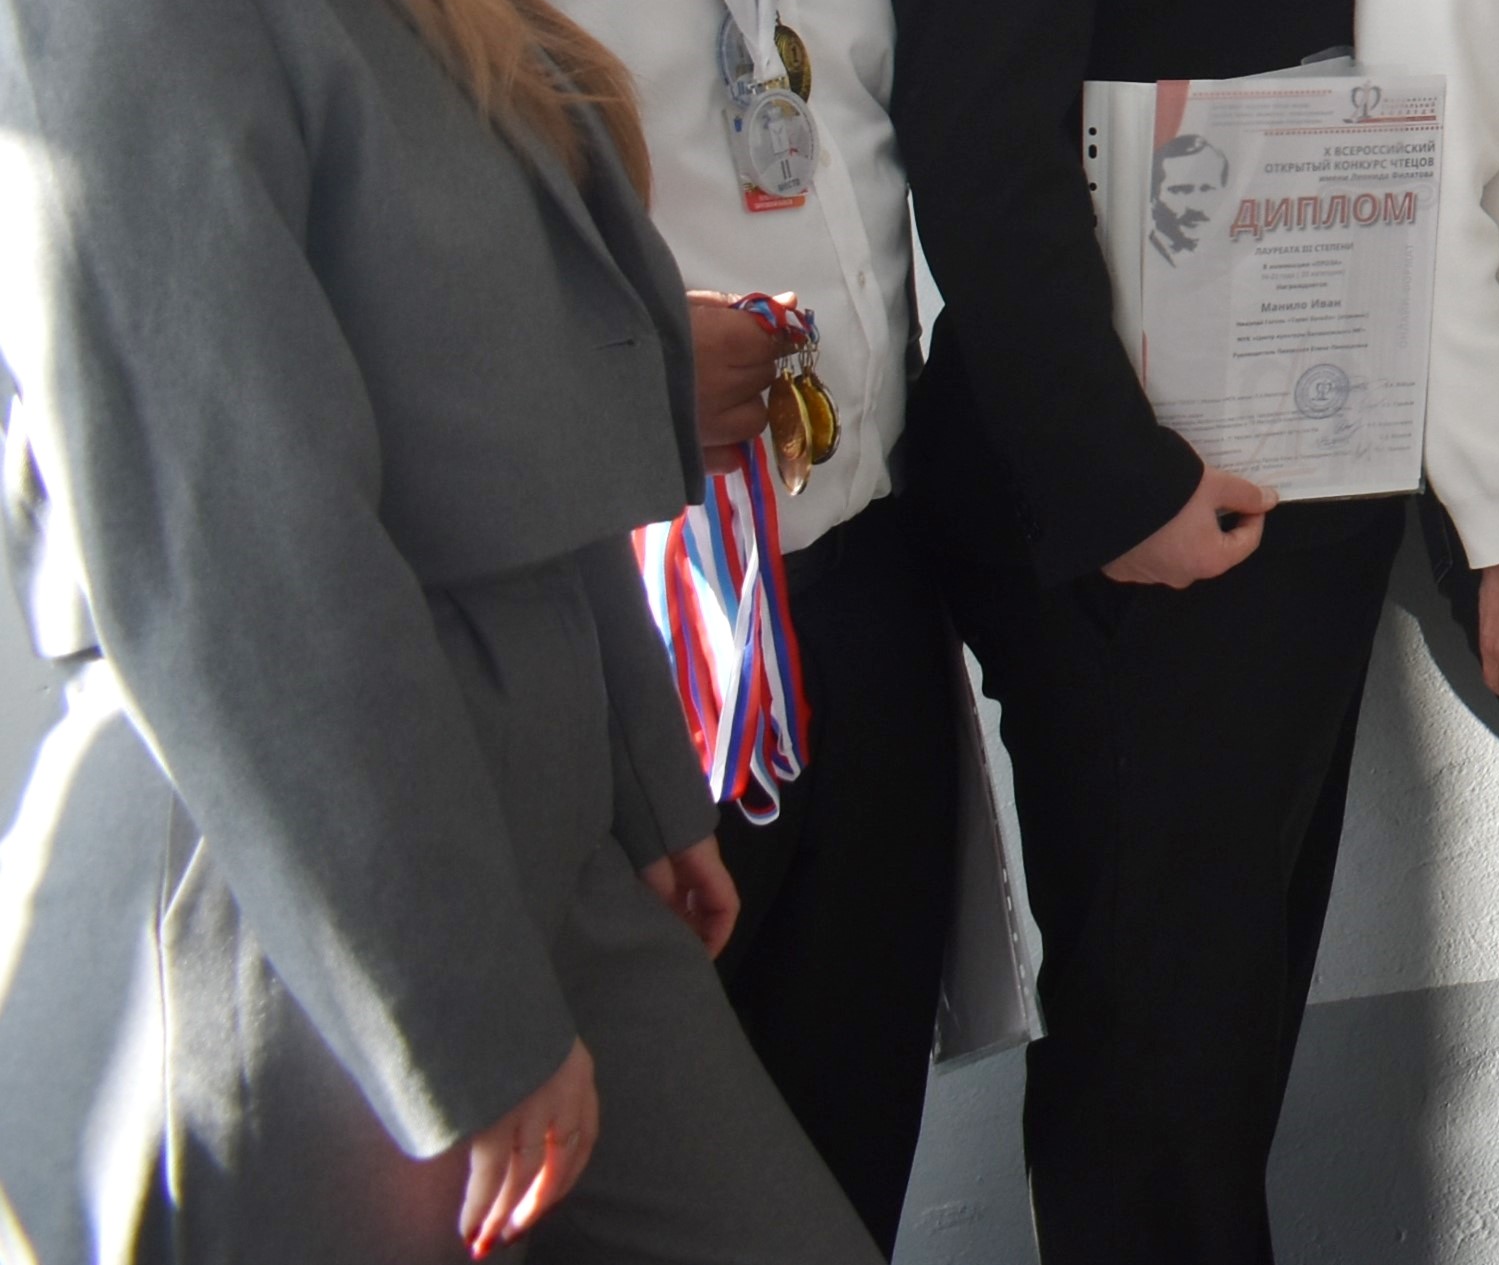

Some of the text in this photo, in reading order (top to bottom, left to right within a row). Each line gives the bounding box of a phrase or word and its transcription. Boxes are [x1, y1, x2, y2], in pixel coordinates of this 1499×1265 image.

[1334, 140, 1436, 157] ВСЕРОССИЙСКИЙ
[1264, 156, 1435, 174] ОТКРЫТЫЙ КОНКУРС ЧТЕЦОВ
[1230, 191, 1417, 240] ДИПЛОМ
[1254, 245, 1299, 256] ЛАУРЕАТА
[1314, 242, 1354, 253] СТЕПЕНИ
[1260, 299, 1342, 313] Манило Иван
